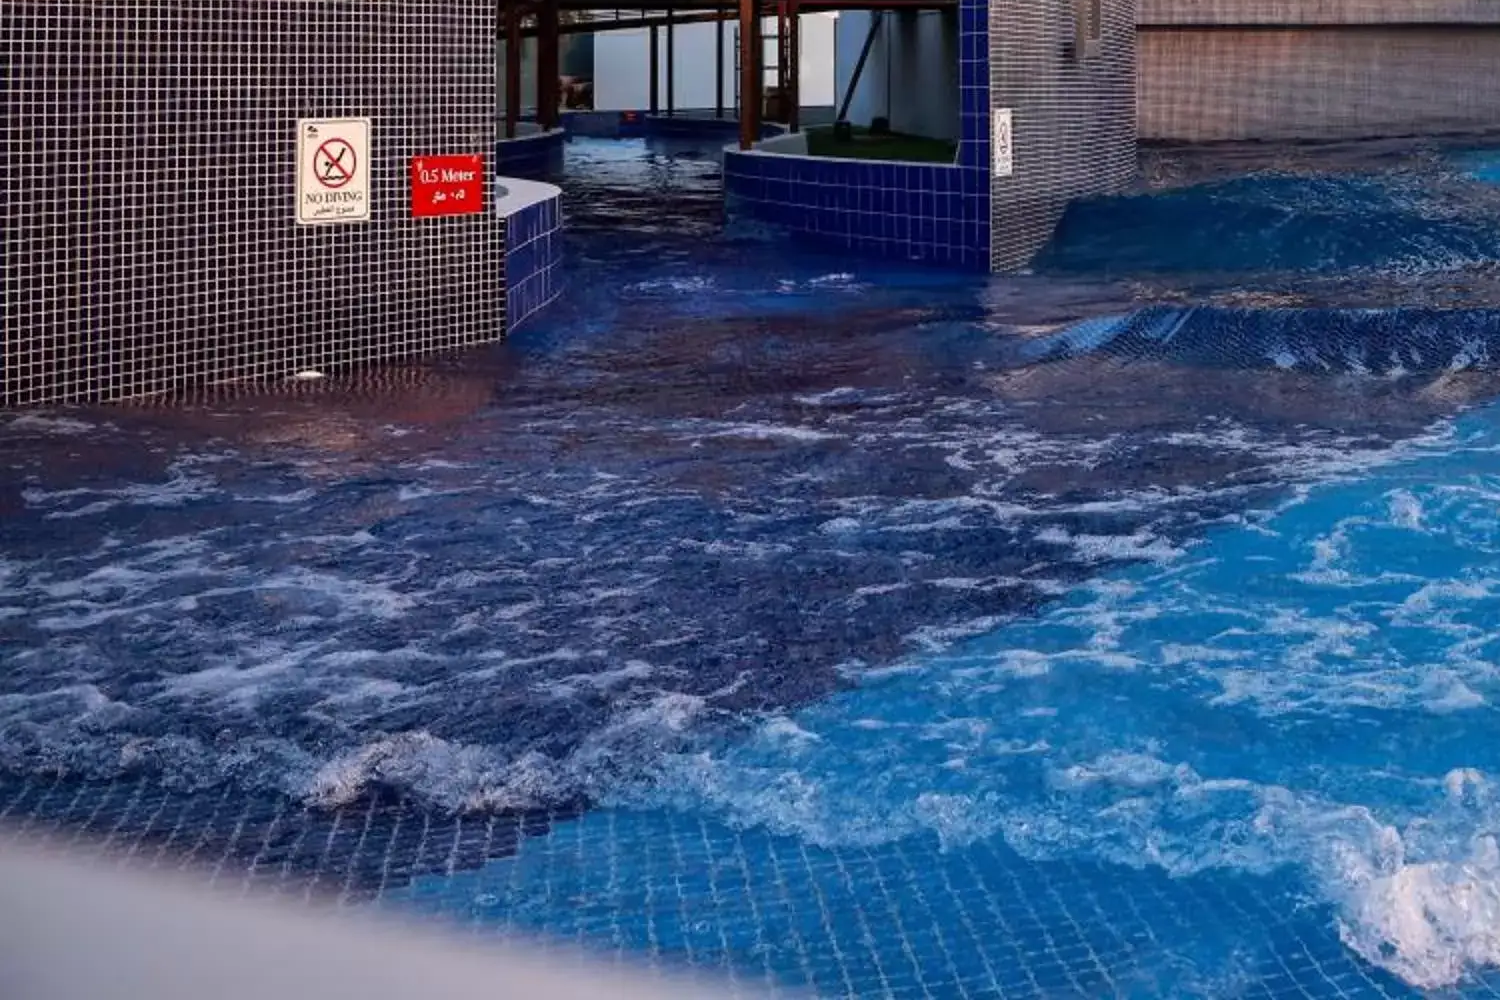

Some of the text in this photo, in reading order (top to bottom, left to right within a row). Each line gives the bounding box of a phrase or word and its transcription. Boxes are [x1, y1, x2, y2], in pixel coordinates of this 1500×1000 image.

[420, 168, 476, 184] 0.5 Meter
[304, 191, 363, 204] NO DIVING
